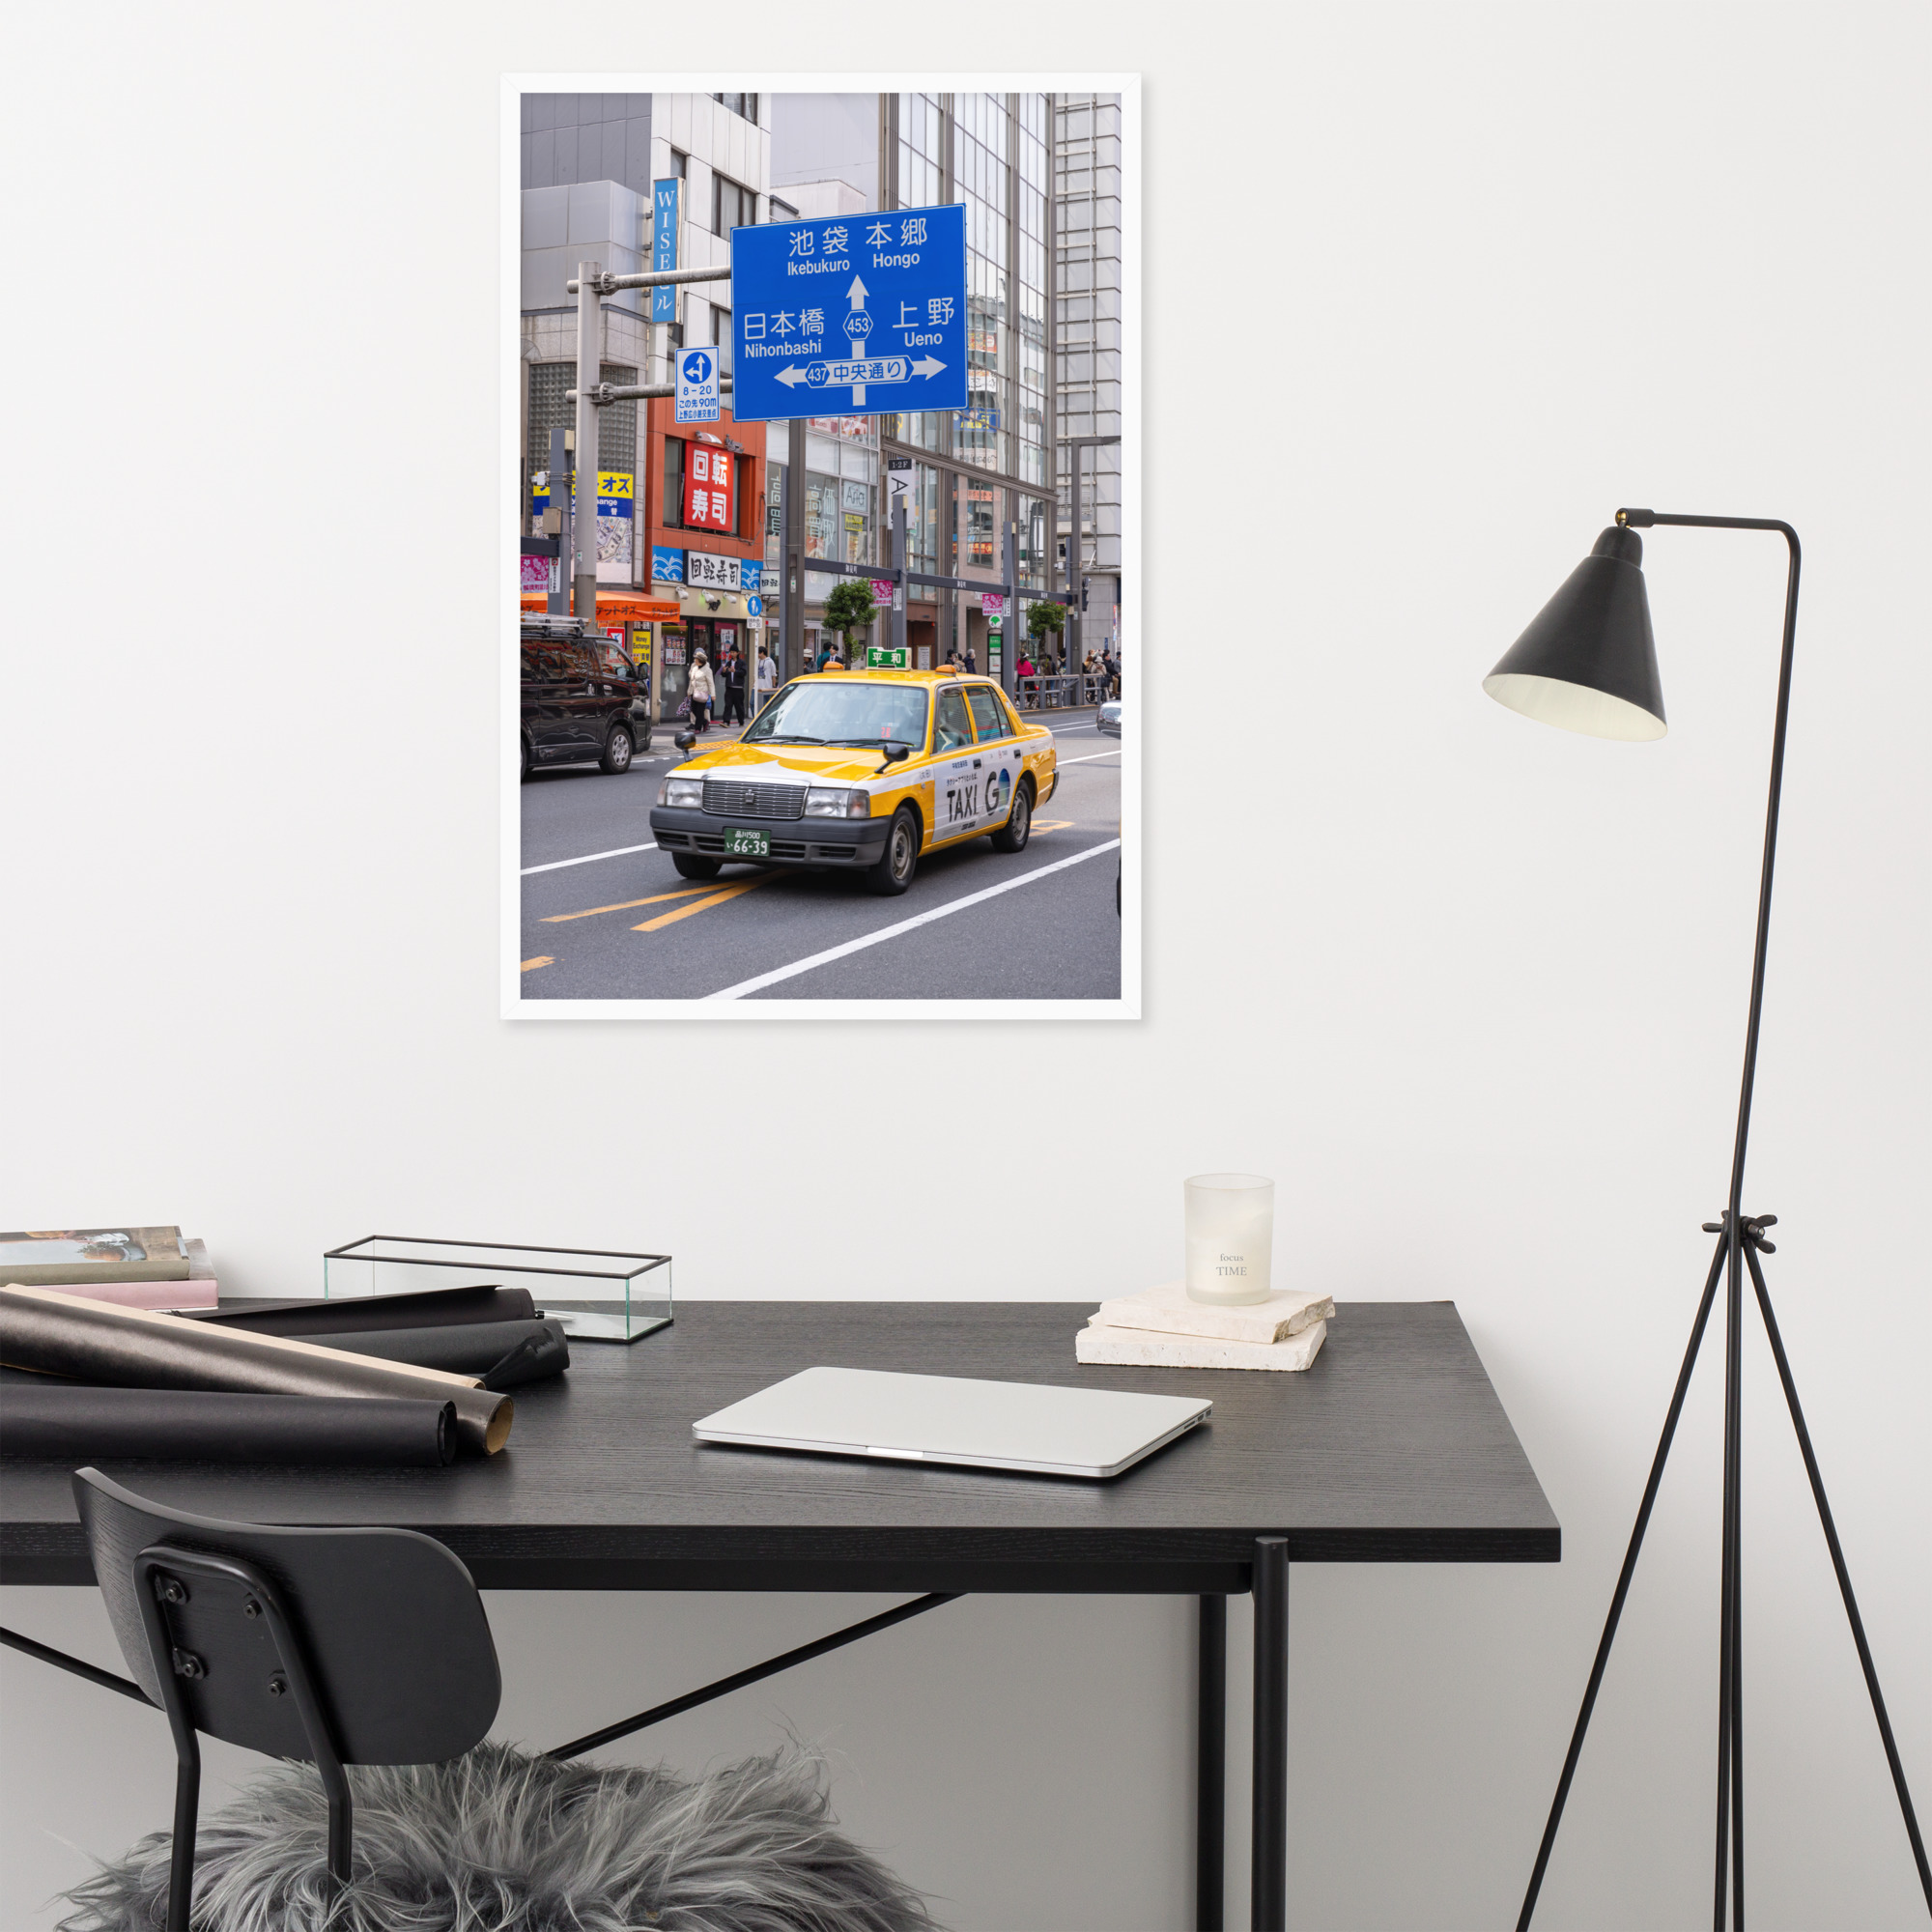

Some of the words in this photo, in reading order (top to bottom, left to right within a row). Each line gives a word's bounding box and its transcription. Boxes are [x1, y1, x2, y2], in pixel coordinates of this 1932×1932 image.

[788, 226, 849, 257] 池袋
[866, 217, 927, 249] 本郷
[656, 190, 675, 312] WISEル
[787, 259, 850, 275] Ikebukuro
[873, 253, 920, 269] Hongo
[745, 308, 825, 340] 日本橋
[893, 298, 954, 328] 上野
[847, 318, 868, 333] 453
[745, 339, 822, 358] Nihonbashi
[904, 331, 943, 347] Ueno
[808, 367, 827, 382] 437
[834, 361, 901, 382] 中央通り
[693, 449, 727, 487] 回転
[692, 488, 726, 525] 寿司
[691, 557, 739, 585] 回転寿司
[872, 652, 901, 664] 平和
[947, 783, 980, 823] TAXI
[734, 839, 768, 855] 66-39
[1220, 1253, 1244, 1262] focus
[1216, 1266, 1247, 1276] TIME
